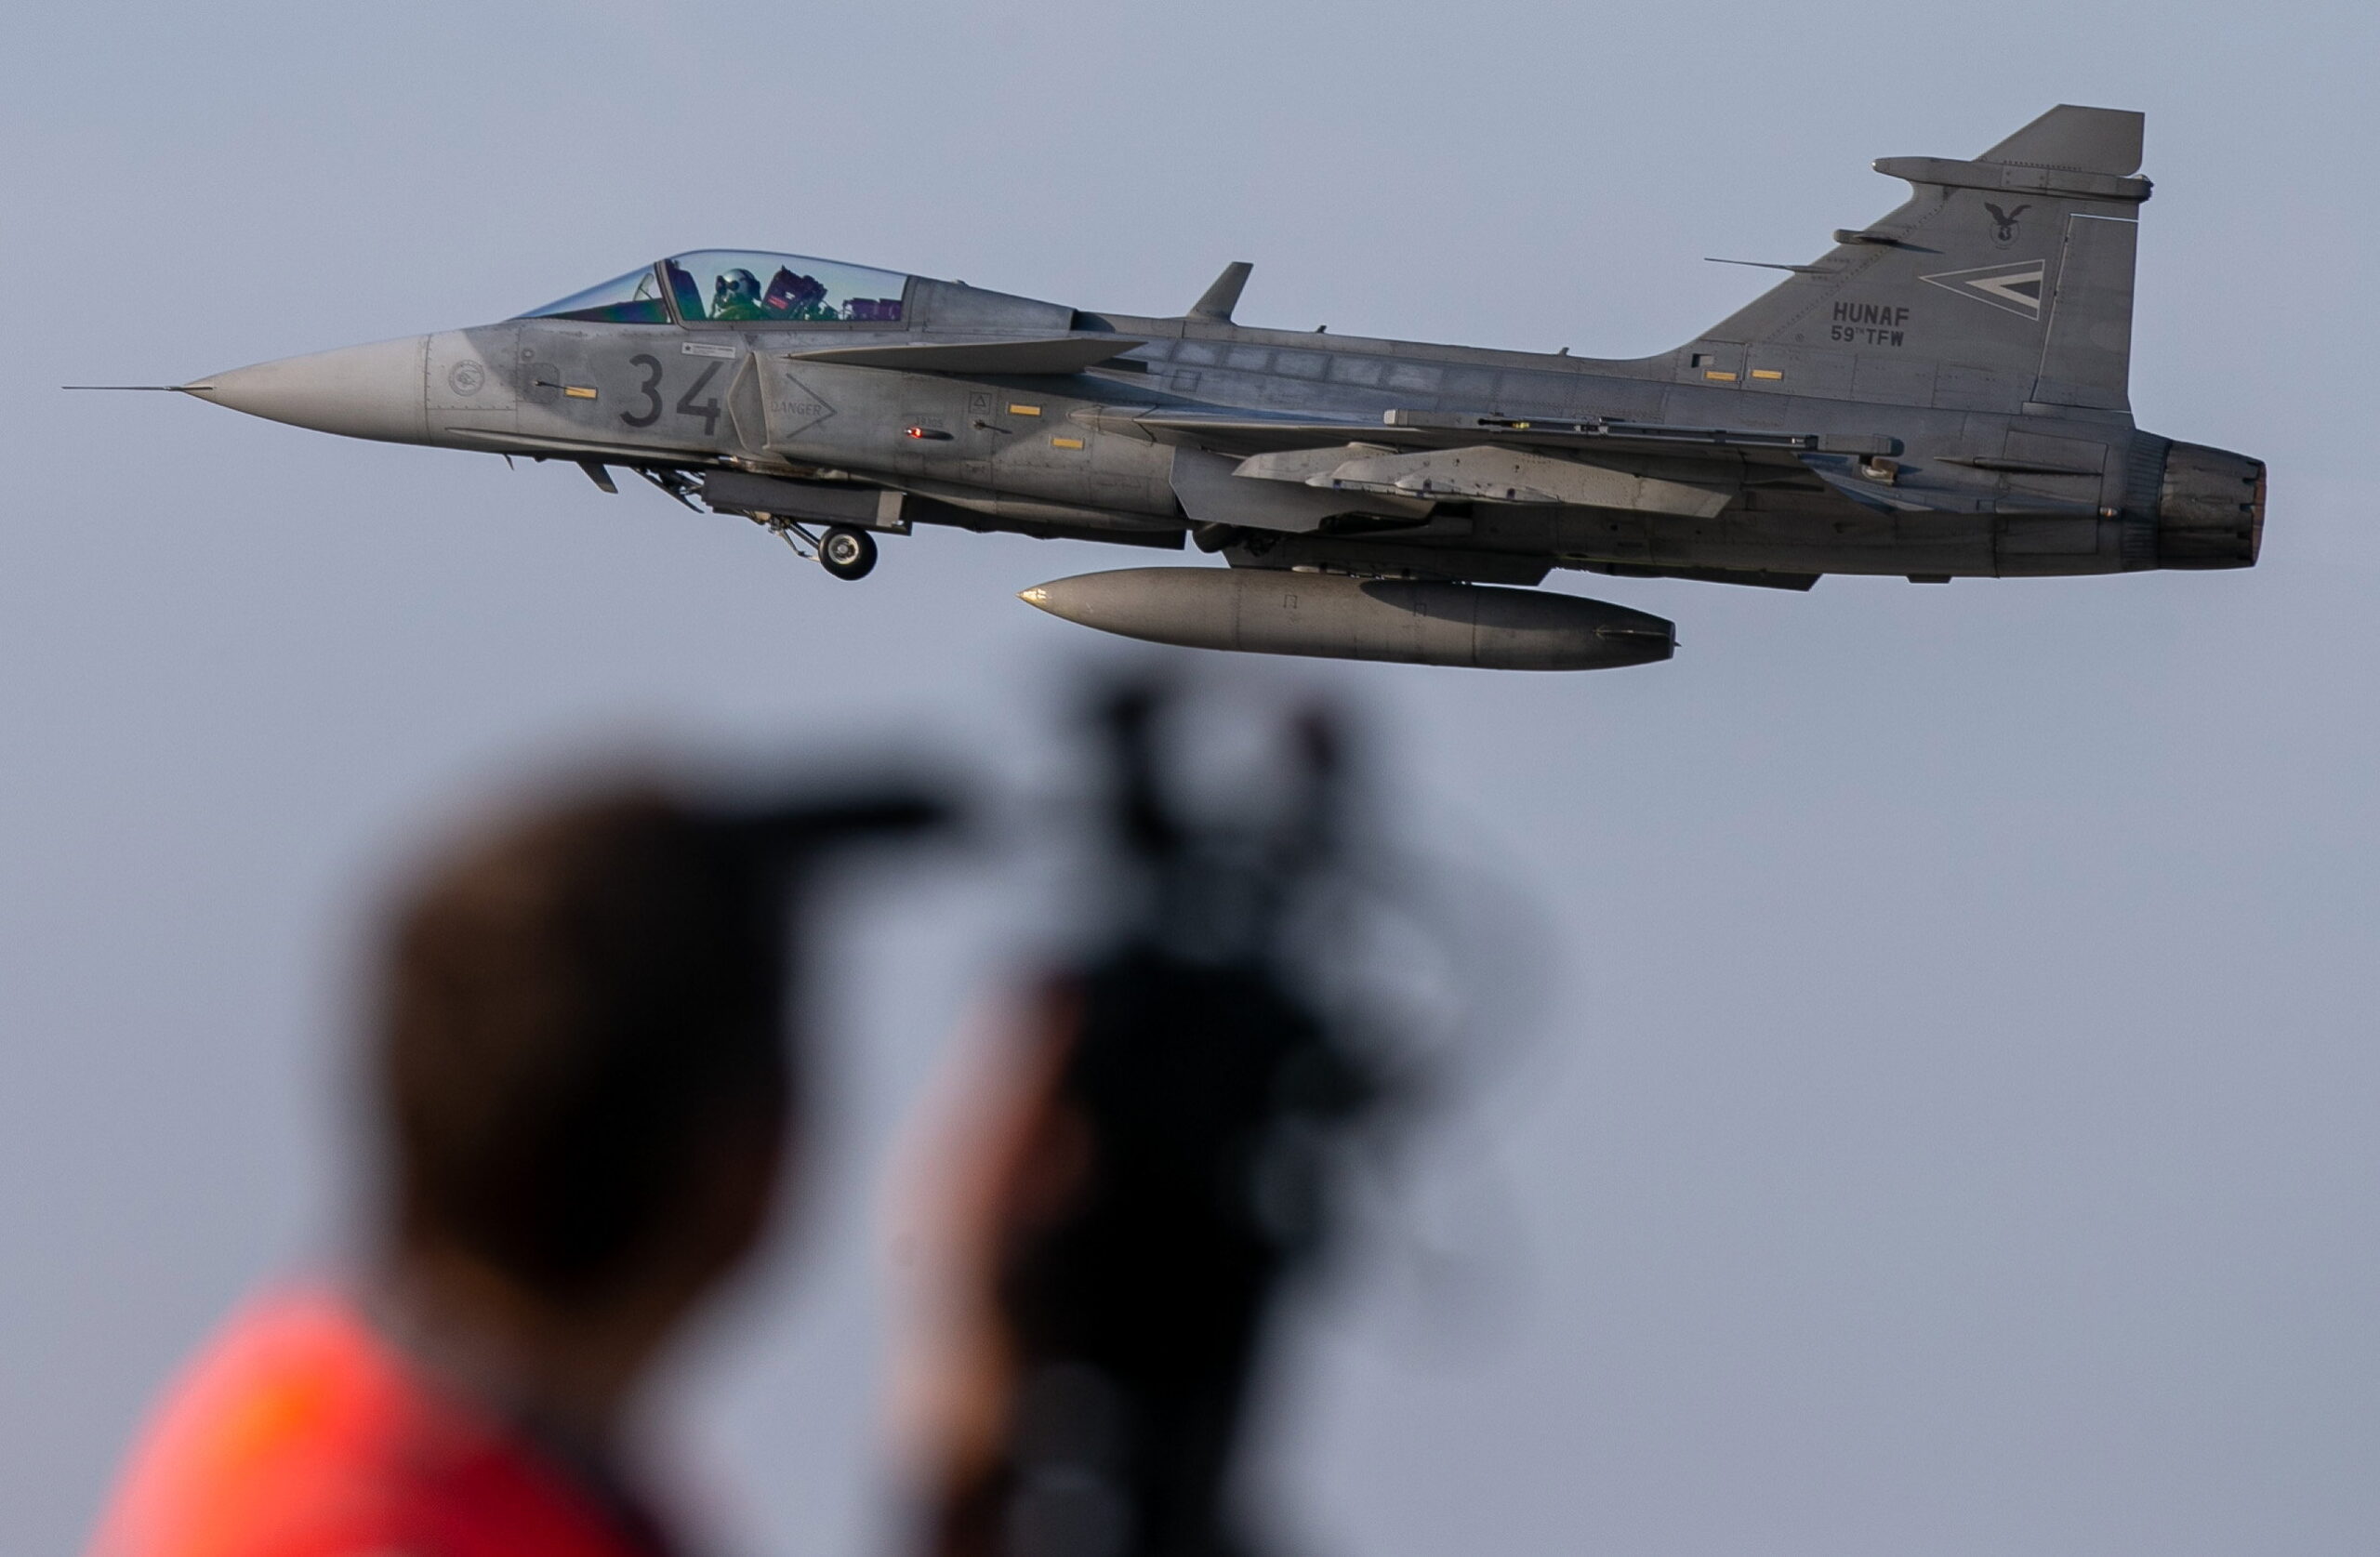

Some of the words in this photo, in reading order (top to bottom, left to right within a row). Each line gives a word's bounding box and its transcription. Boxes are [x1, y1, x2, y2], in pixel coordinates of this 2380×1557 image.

[1833, 301, 1910, 327] HUNAF
[619, 352, 724, 436] 34
[770, 401, 822, 416] DANGER
